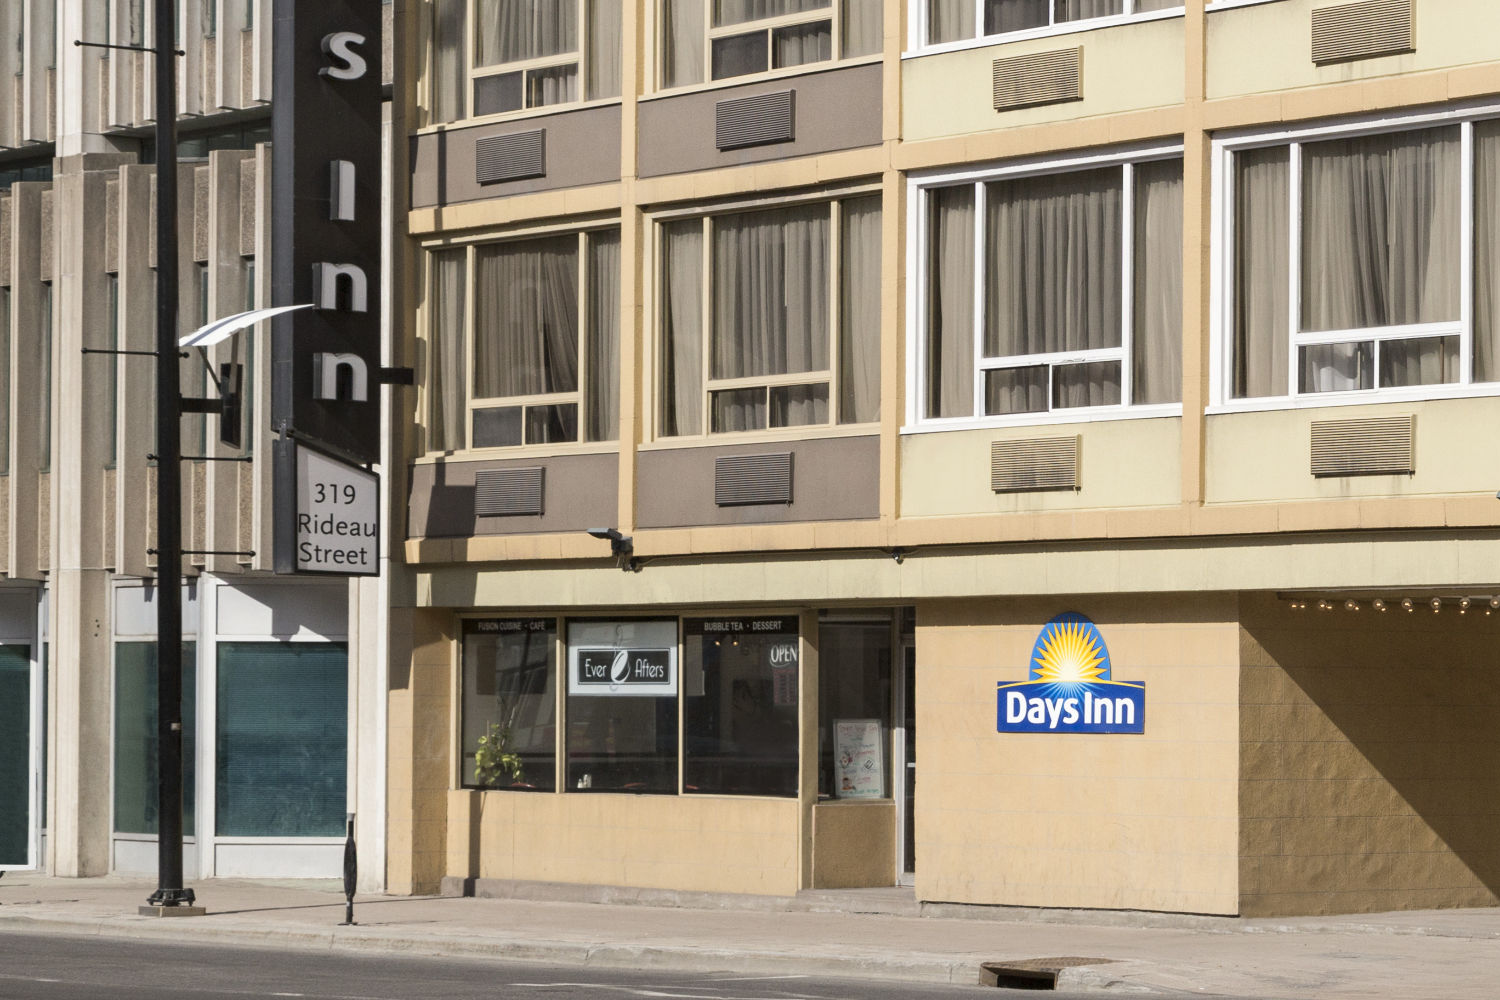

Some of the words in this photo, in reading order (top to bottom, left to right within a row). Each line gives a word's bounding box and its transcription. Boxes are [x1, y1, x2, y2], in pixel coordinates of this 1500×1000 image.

[313, 159, 367, 402] Inn
[314, 483, 355, 504] 319
[298, 513, 376, 537] Rideau
[299, 542, 367, 565] Street
[704, 622, 729, 631] BUBBLE
[731, 622, 743, 631] TEA
[752, 621, 782, 630] DESSERT
[770, 645, 797, 662] OPEN
[585, 658, 607, 677] Ever
[635, 658, 664, 677] Afters
[1006, 691, 1079, 729] Days
[1084, 691, 1135, 724] Inn
